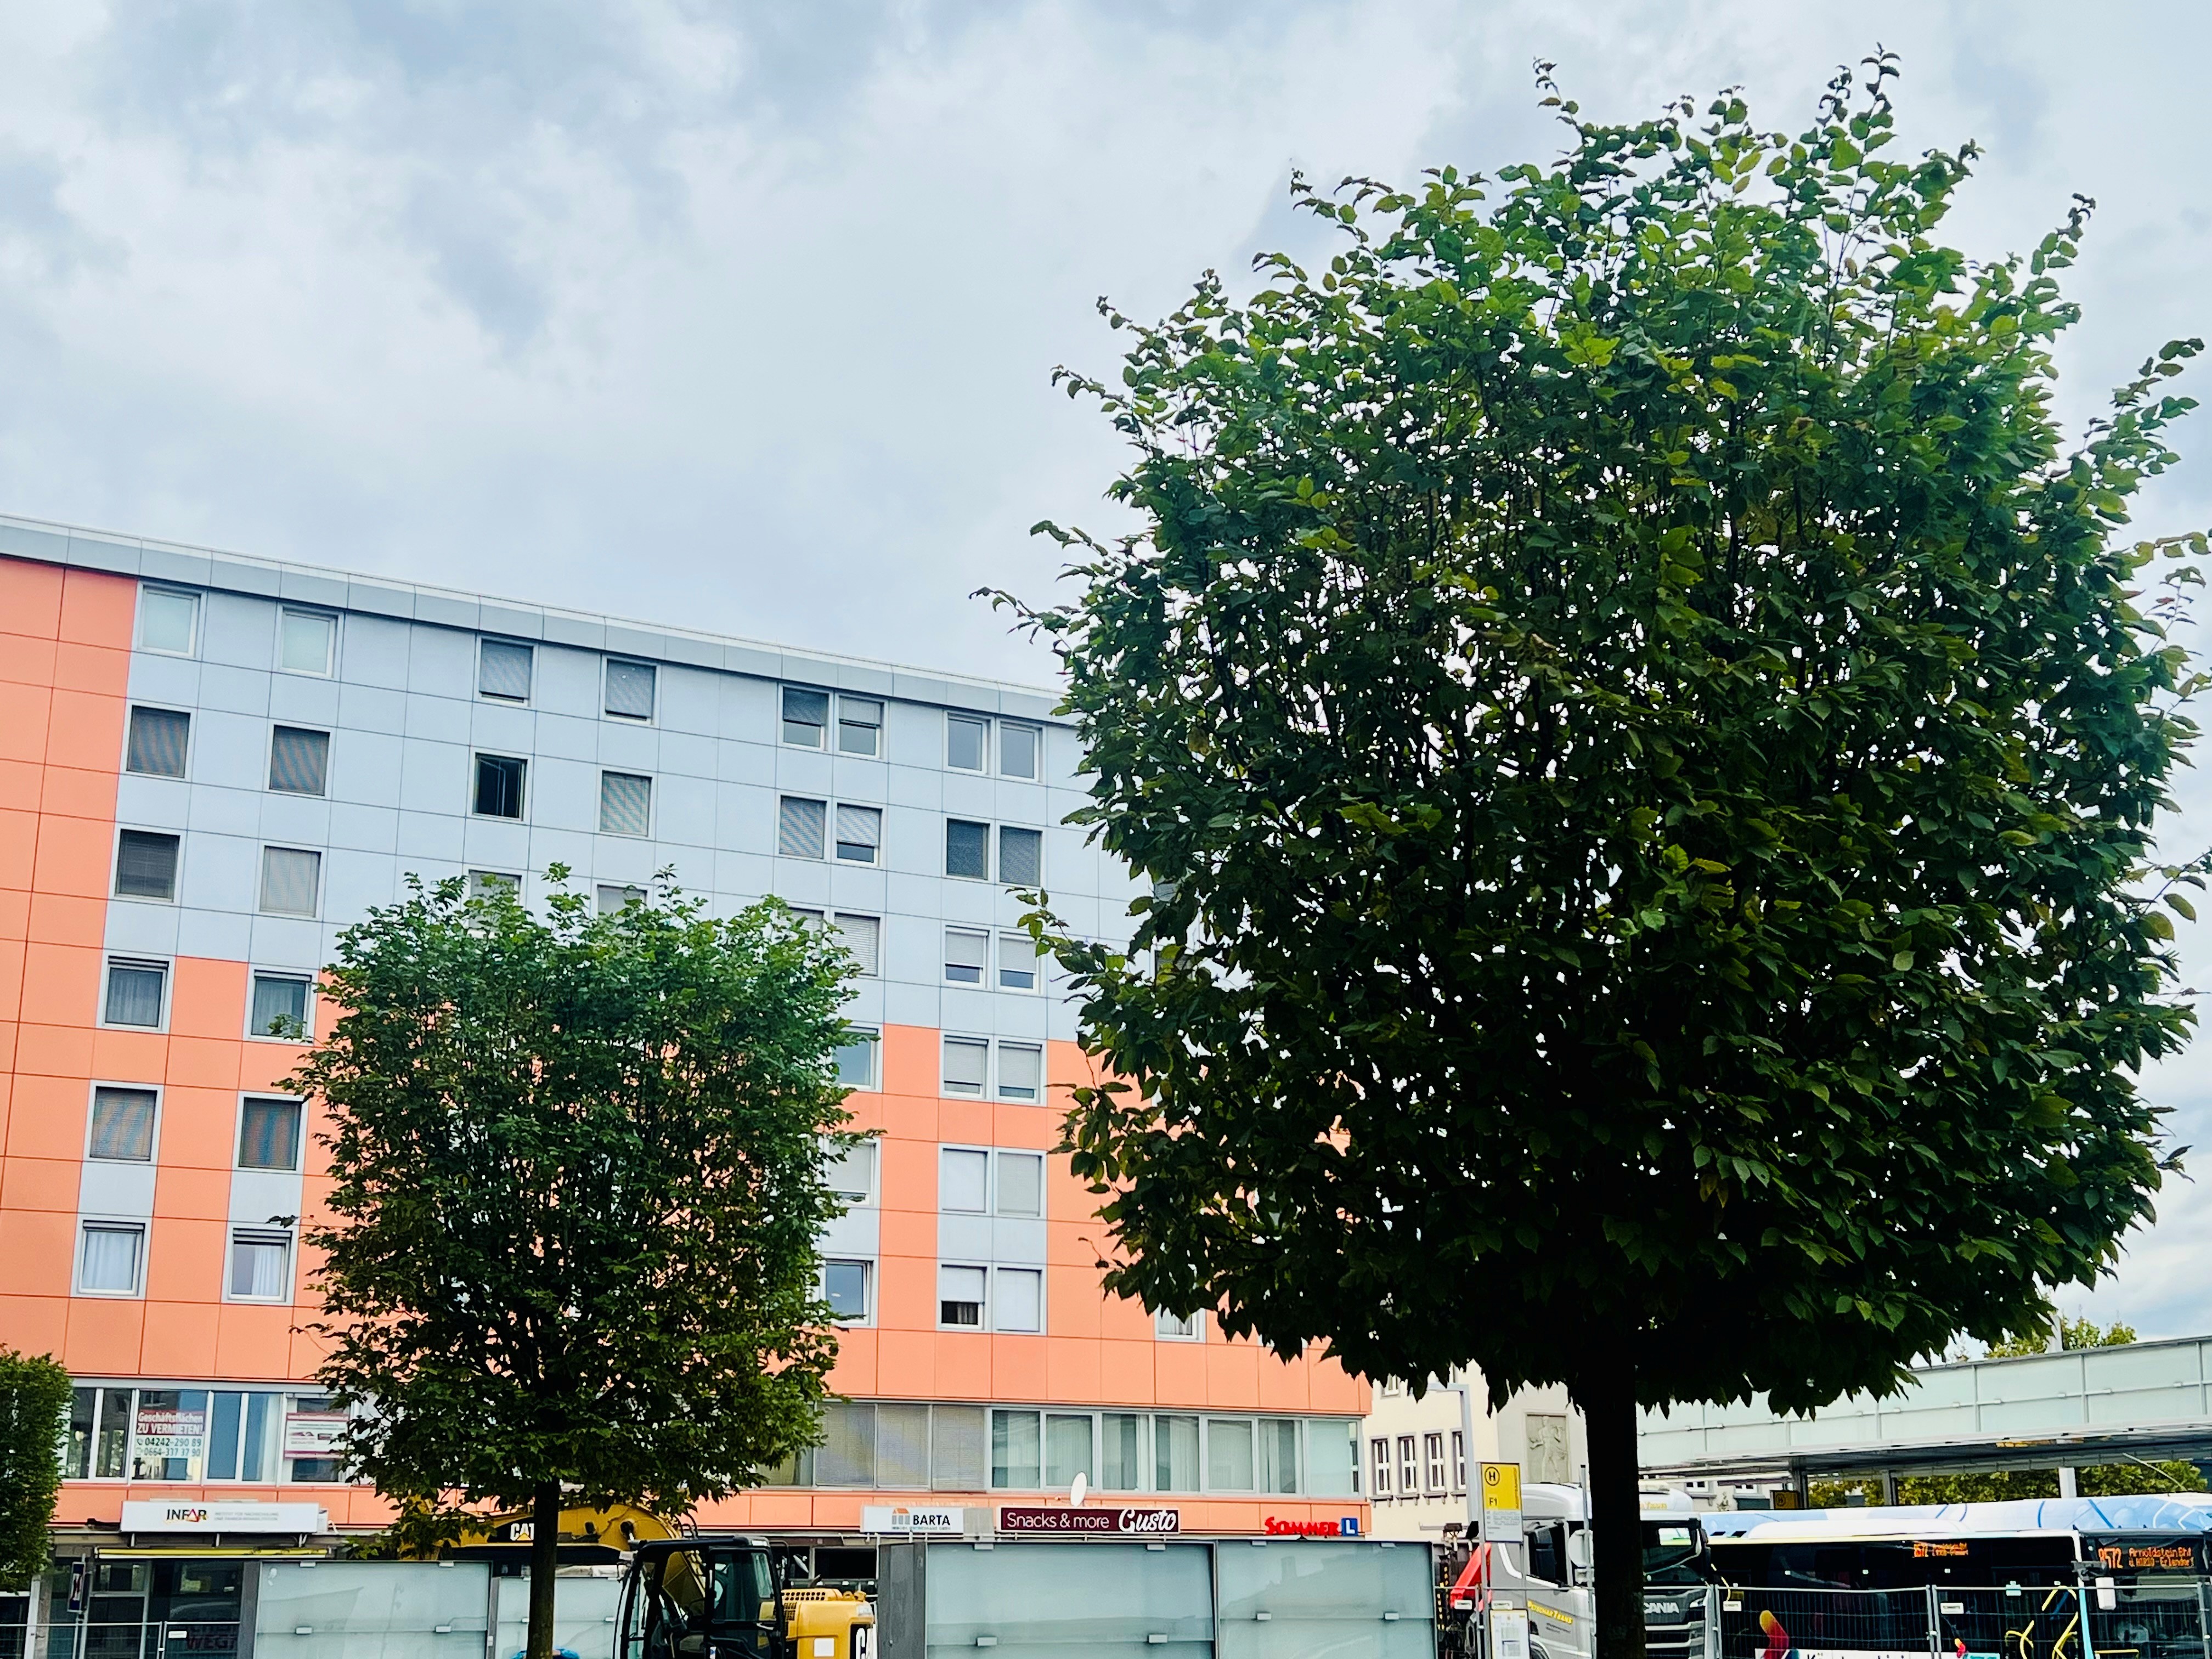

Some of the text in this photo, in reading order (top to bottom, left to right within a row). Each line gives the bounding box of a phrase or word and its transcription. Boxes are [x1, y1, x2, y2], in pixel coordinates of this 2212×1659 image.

[138, 1412, 203, 1423] Geschäftsflächen
[137, 1423, 203, 1435] ZU VERMIETEN!
[145, 1437, 202, 1447] 04242-290 89
[1489, 1471, 1496, 1481] H
[1489, 1498, 1498, 1506] F1
[913, 1515, 950, 1525] BARTA
[1007, 1509, 1176, 1532] Snacks & more Gusto
[1346, 1519, 1356, 1534] L
